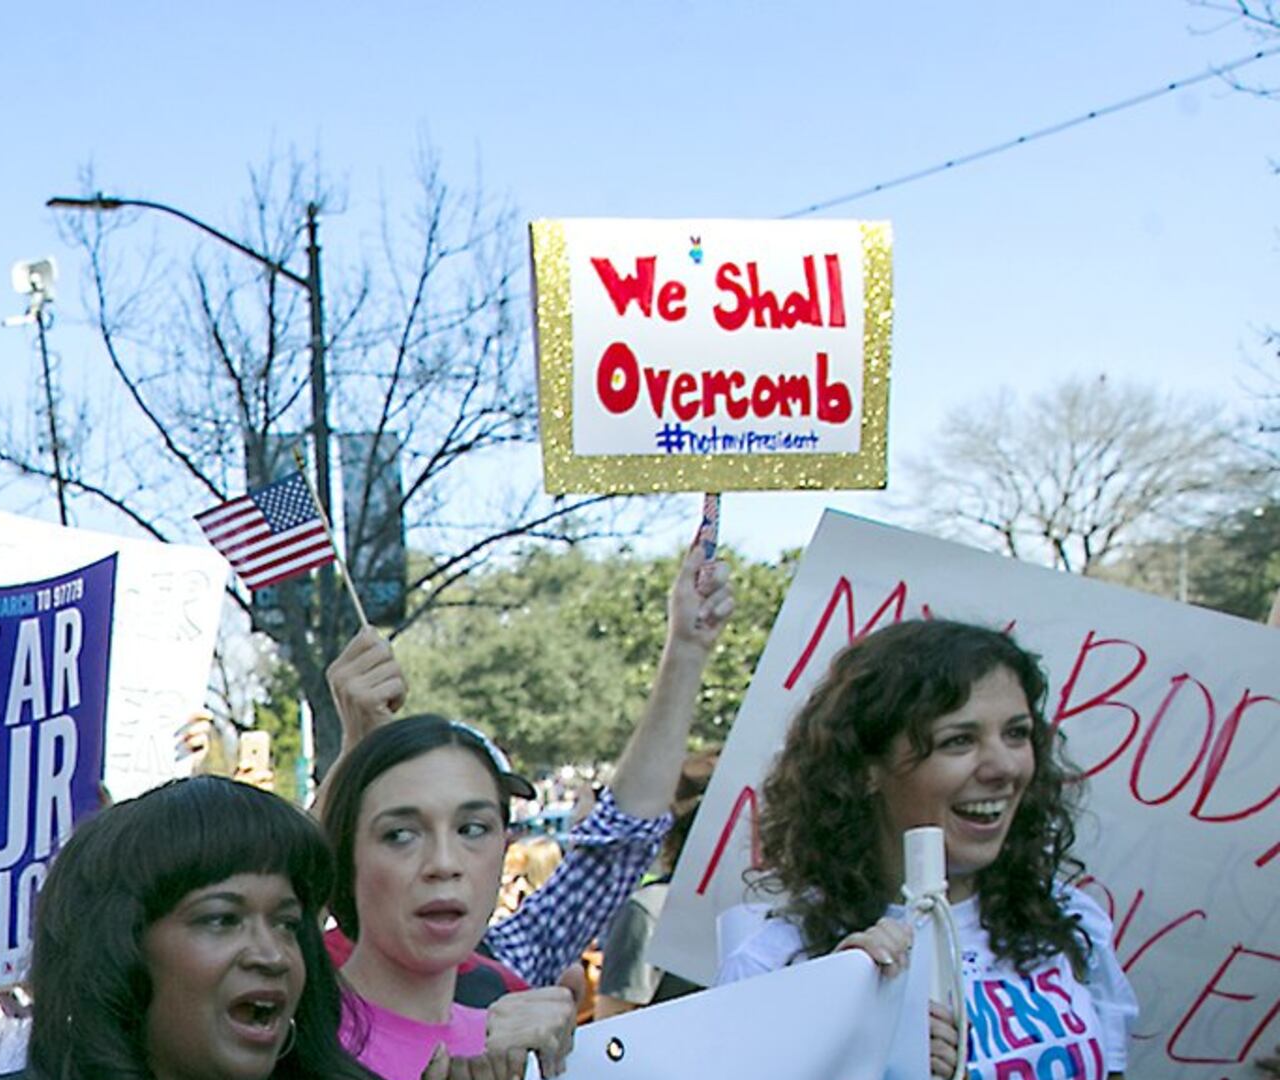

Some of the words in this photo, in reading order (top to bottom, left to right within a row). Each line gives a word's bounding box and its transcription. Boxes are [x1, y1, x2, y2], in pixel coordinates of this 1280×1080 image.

[590, 254, 686, 322] We
[713, 253, 846, 331] Shall
[596, 341, 853, 424] Overcomb
[37, 588, 52, 612] TO
